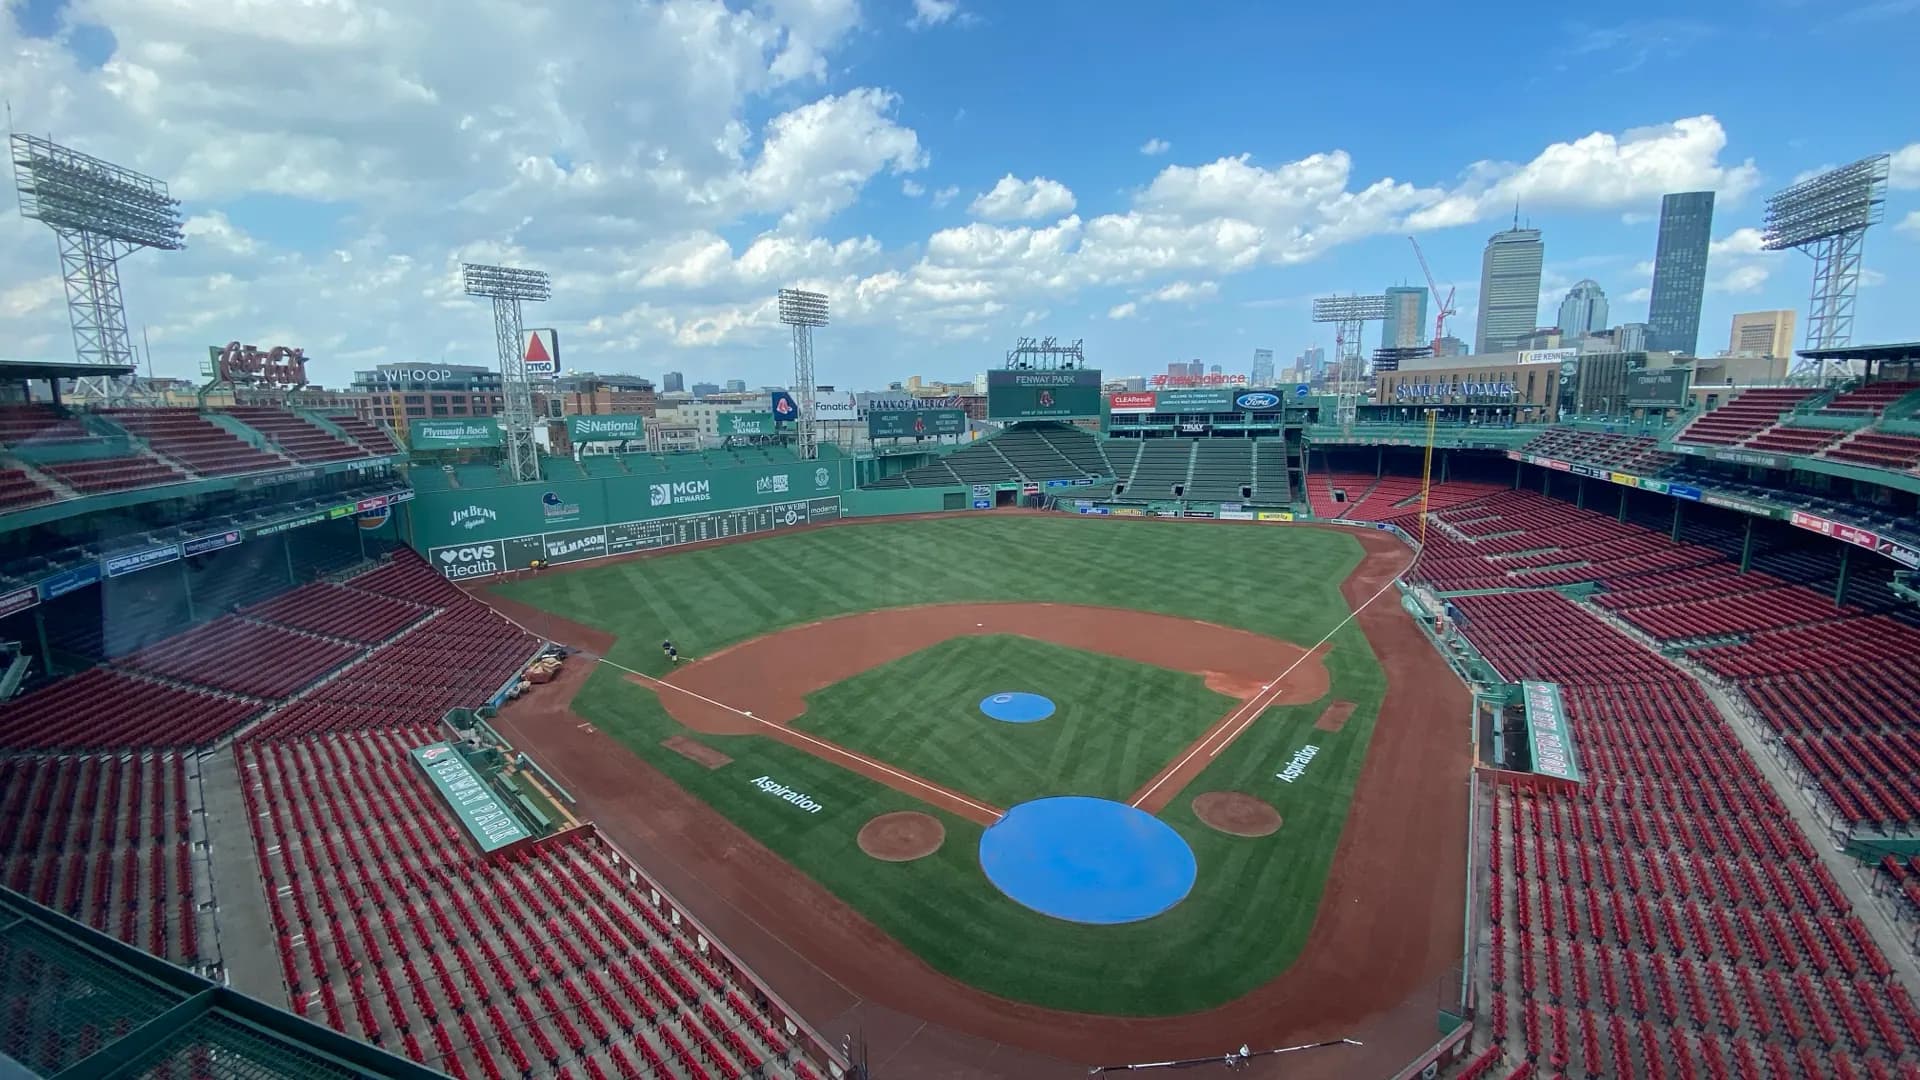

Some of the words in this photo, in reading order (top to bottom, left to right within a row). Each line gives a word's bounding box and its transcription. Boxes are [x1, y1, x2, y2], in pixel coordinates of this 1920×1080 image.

[526, 362, 552, 372] CITGO
[383, 369, 451, 382] WHOOP
[1016, 375, 1050, 384] FENWAY
[1052, 375, 1075, 384] PARK
[1169, 375, 1194, 384] new
[1194, 373, 1246, 385] balance
[911, 399, 948, 410] AMERICA
[1244, 395, 1271, 406] Ford
[423, 427, 465, 437] Plymouth
[590, 420, 638, 432] National
[672, 480, 710, 496] MGM
[673, 493, 711, 504] REWARDS
[450, 509, 469, 526] JIM
[470, 506, 496, 520] BEAM
[458, 546, 495, 562] CVS
[444, 560, 497, 578] Health
[1276, 744, 1320, 783] Aspiration
[434, 757, 490, 806] FENWAY
[469, 802, 520, 843] PARK
[750, 776, 823, 814] Aspiration
